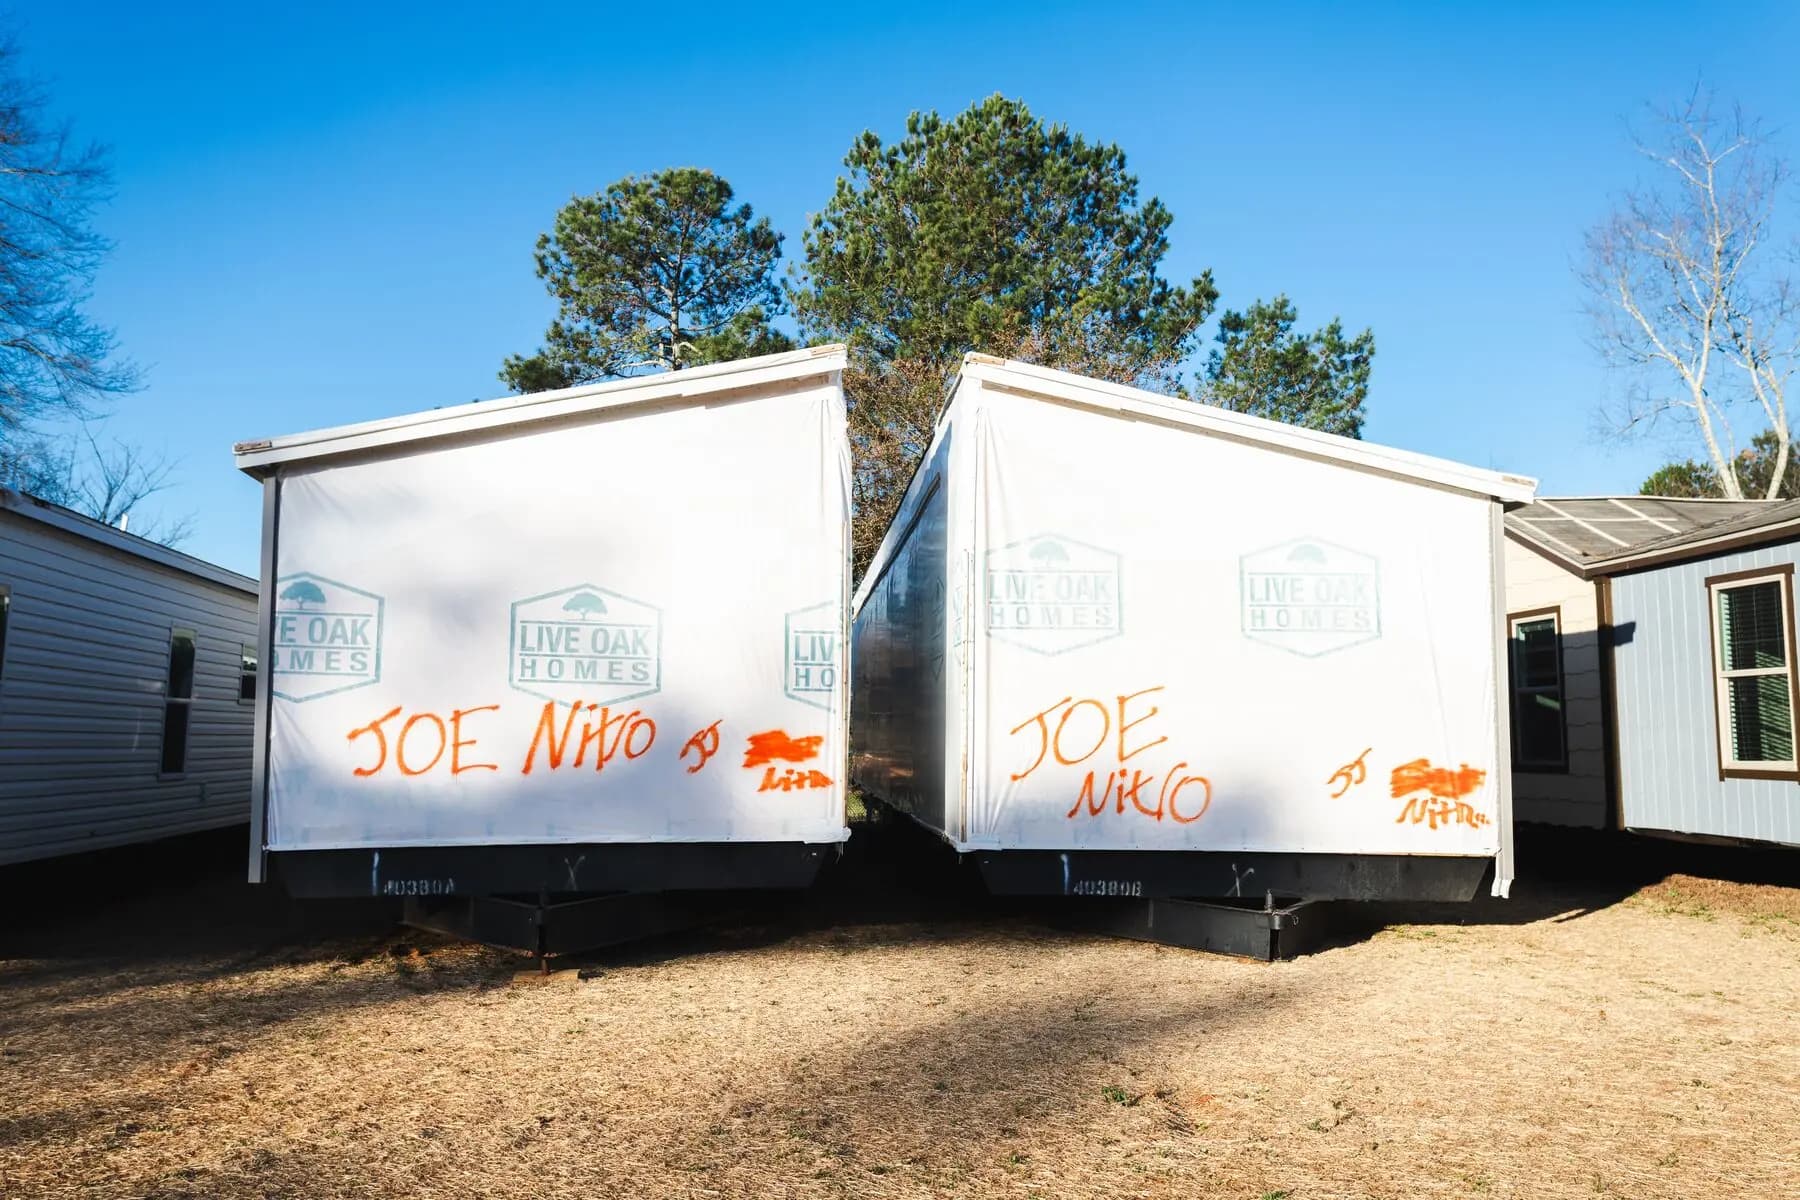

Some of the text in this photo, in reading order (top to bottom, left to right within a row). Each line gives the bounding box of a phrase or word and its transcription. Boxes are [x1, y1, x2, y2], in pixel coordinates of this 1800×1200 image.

[1056, 575, 1112, 601] OAK
[1248, 577, 1369, 603] LIVE OAK
[991, 606, 1113, 625] HOMES
[1250, 608, 1371, 628] HOMES
[308, 617, 371, 645] OAK
[520, 625, 650, 656] LIVE OAK
[520, 657, 650, 682] HOMES
[346, 703, 500, 777] JOE
[1009, 686, 1168, 782] JOE
